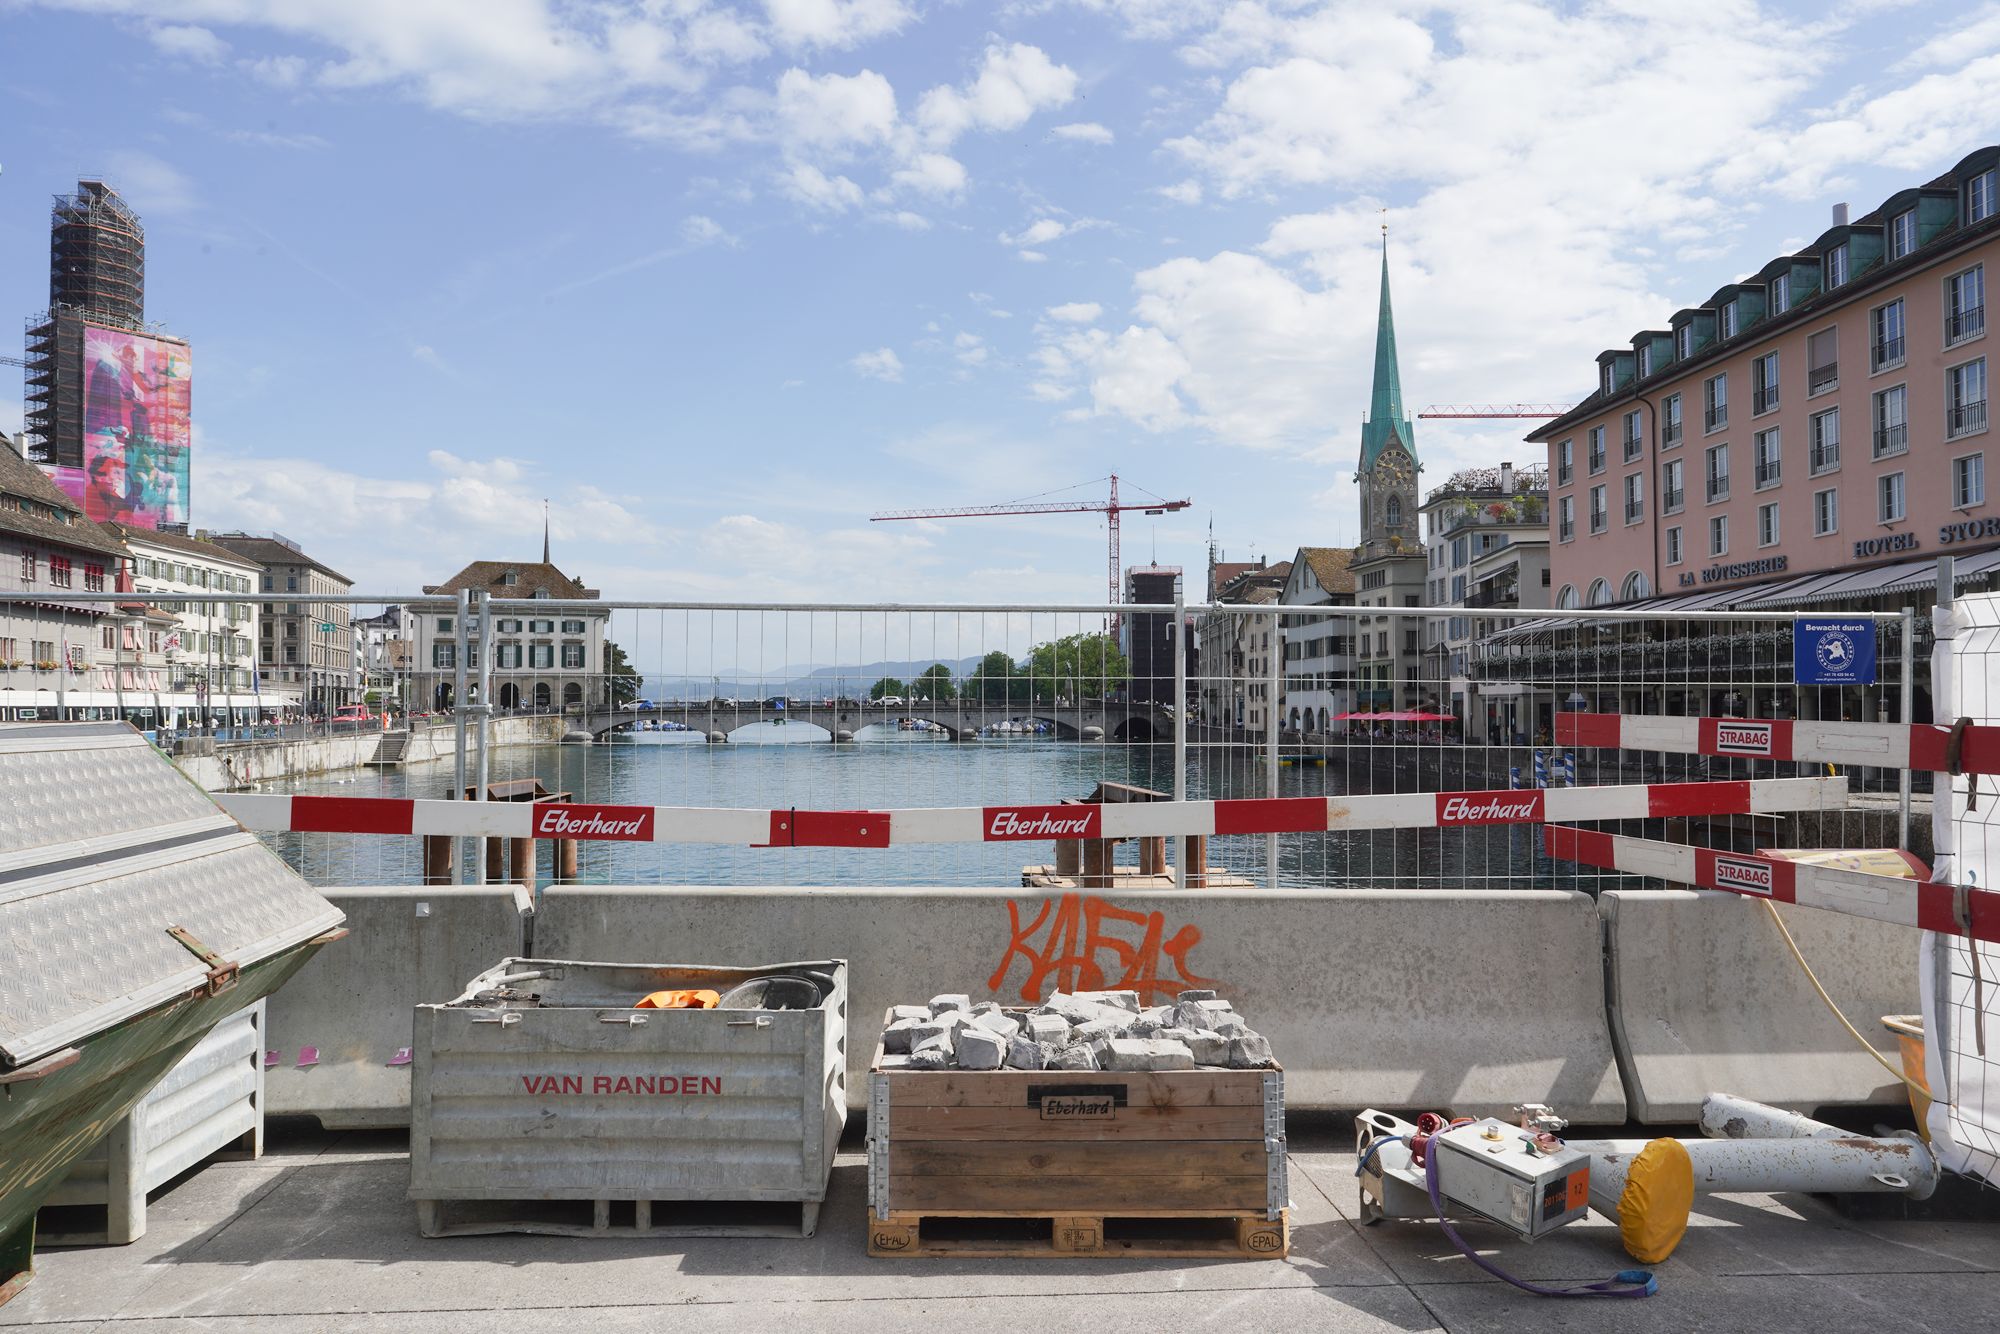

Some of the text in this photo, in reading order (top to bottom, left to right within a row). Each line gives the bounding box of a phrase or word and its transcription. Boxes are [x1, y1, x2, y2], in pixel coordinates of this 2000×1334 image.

[1853, 532, 1918, 557] HOTEL
[1679, 572, 1695, 586] LA
[1719, 731, 1768, 745] STRABAG
[1442, 797, 1538, 820] Eberhard
[540, 810, 646, 835] Eberhard
[990, 812, 1093, 835] Eberhard
[1718, 865, 1769, 884] STRABAG
[522, 1076, 721, 1095] VAN RANDEN
[1047, 1100, 1110, 1115] Eberhard
[1252, 1235, 1277, 1248] EPAL
